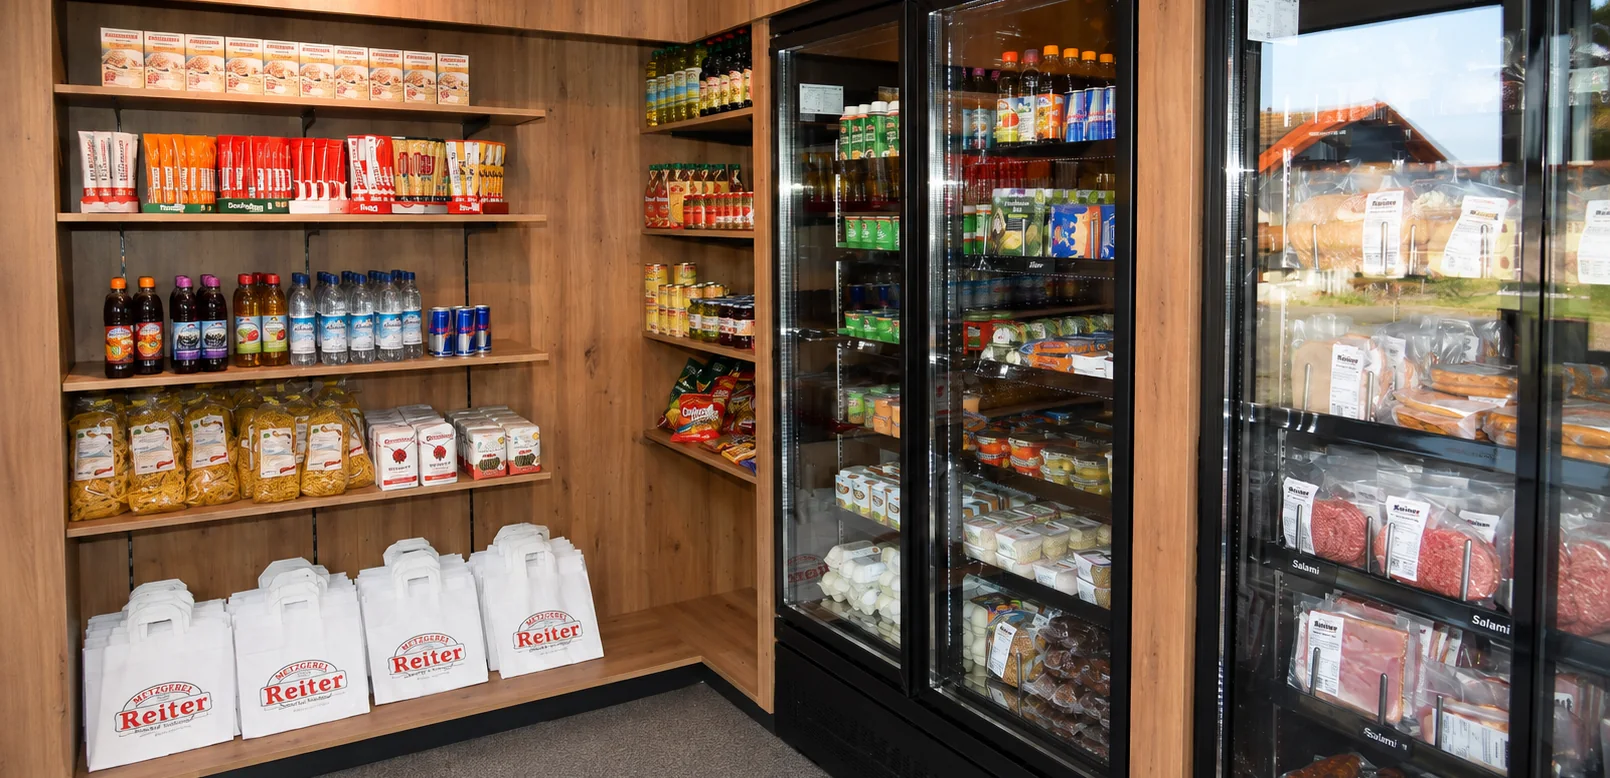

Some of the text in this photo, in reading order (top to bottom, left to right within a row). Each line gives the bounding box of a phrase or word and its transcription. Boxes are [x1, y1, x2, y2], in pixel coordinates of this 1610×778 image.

[1292, 559, 1320, 575] Salami
[1471, 614, 1511, 635] Salami
[401, 634, 449, 651] METZGEREI
[516, 624, 579, 648] Reiter
[275, 661, 329, 680] METZGEREI
[392, 647, 462, 674] Reiter
[133, 683, 193, 705] METZGEREI
[264, 674, 343, 705] Reiter
[119, 696, 208, 731] Reiter
